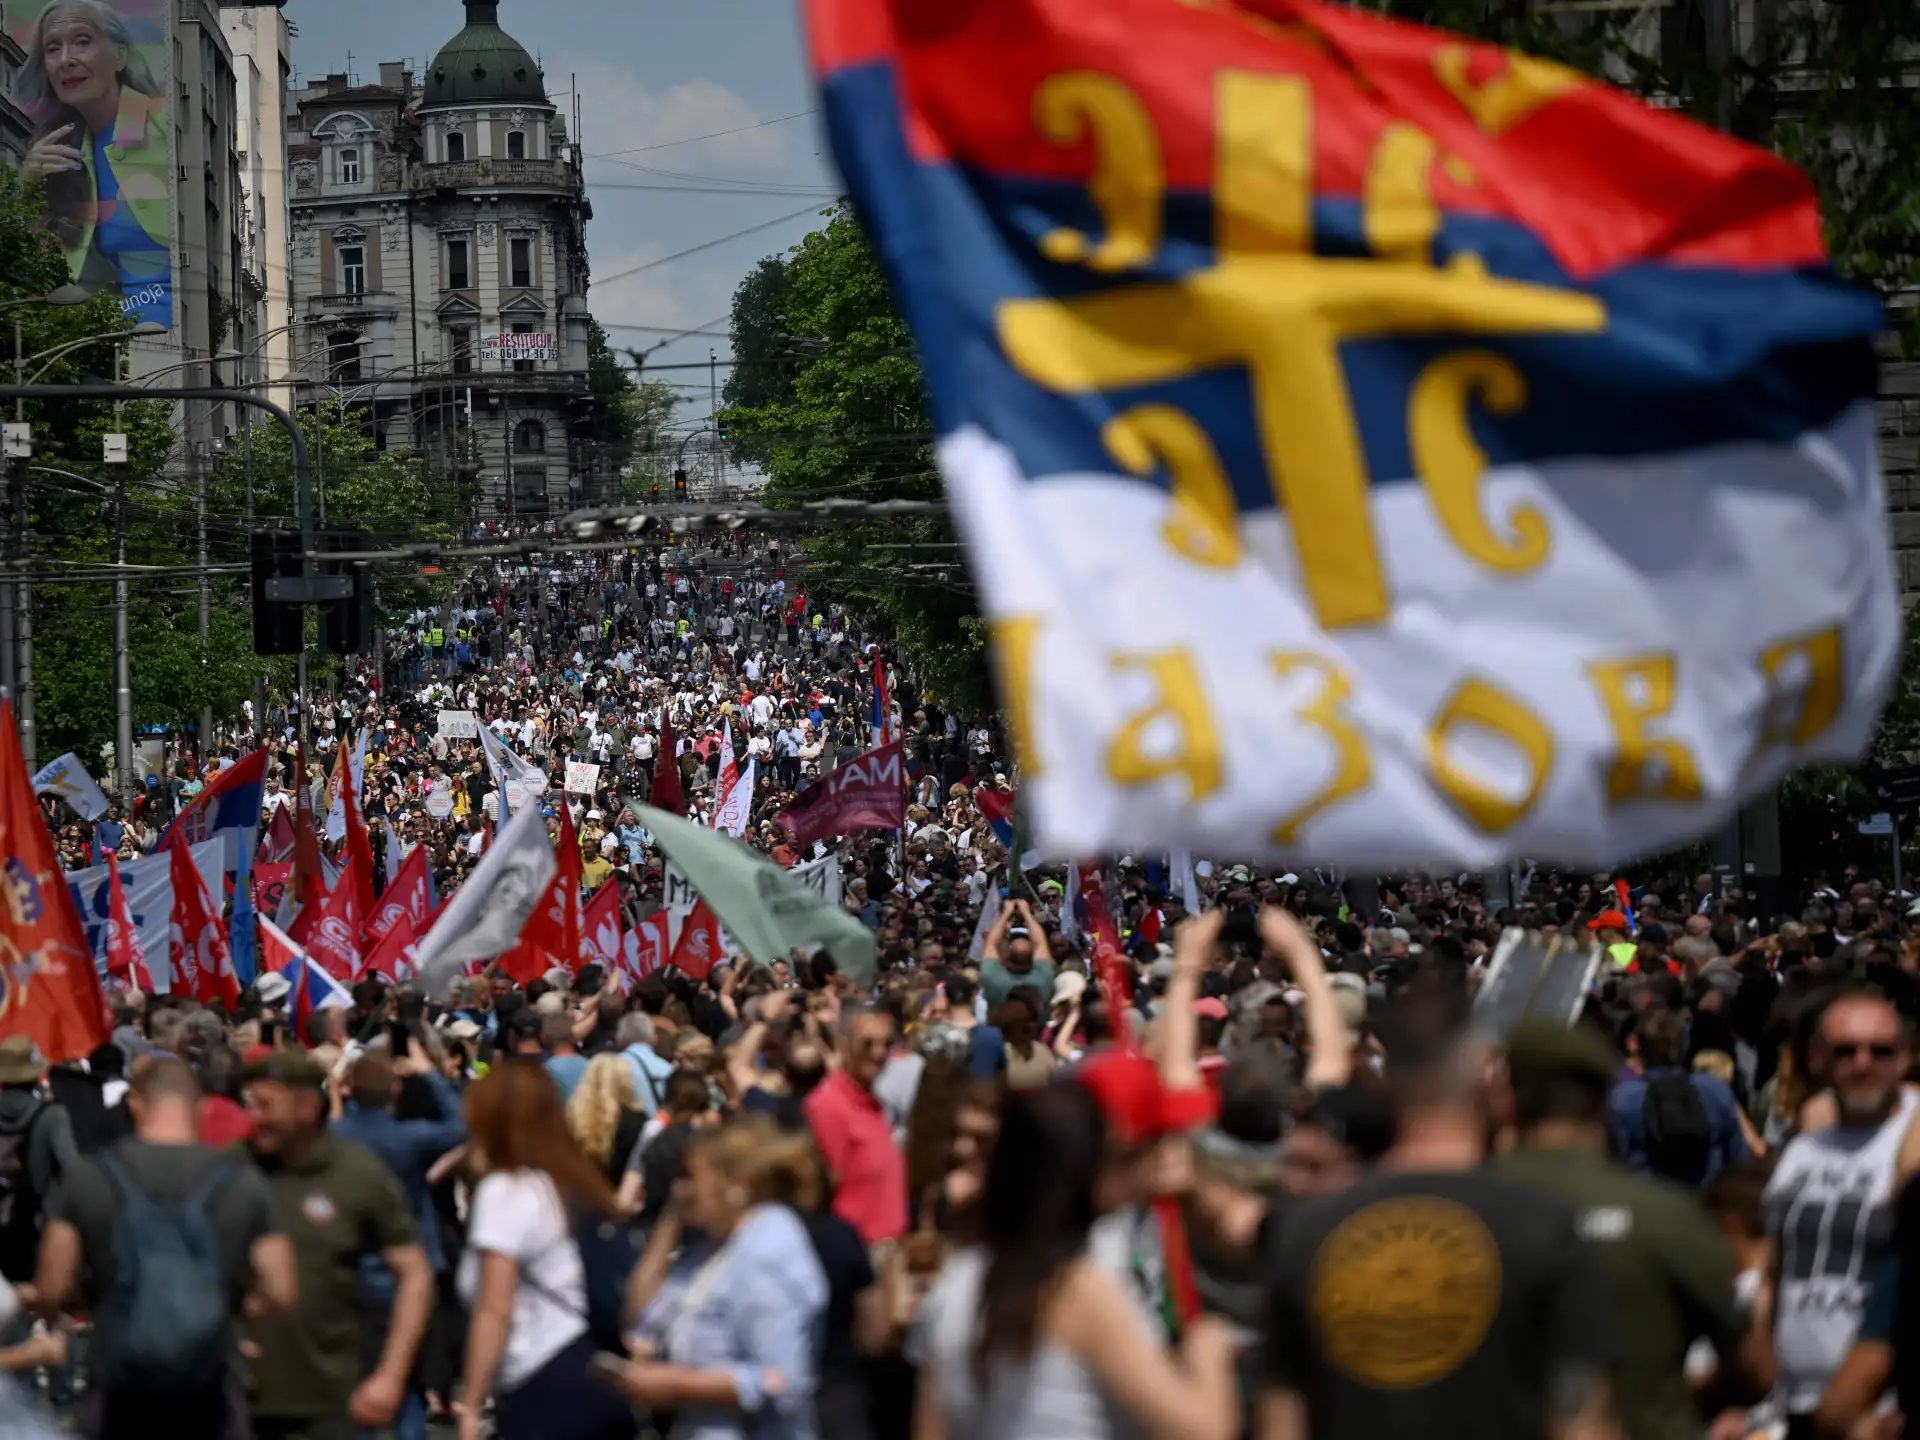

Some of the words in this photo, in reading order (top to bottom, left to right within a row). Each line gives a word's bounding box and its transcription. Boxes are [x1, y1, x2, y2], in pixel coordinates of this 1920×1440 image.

[481, 350, 497, 359] Tel:
[500, 348, 518, 359] 060
[522, 348, 530, 359] 17
[534, 348, 544, 359] 36
